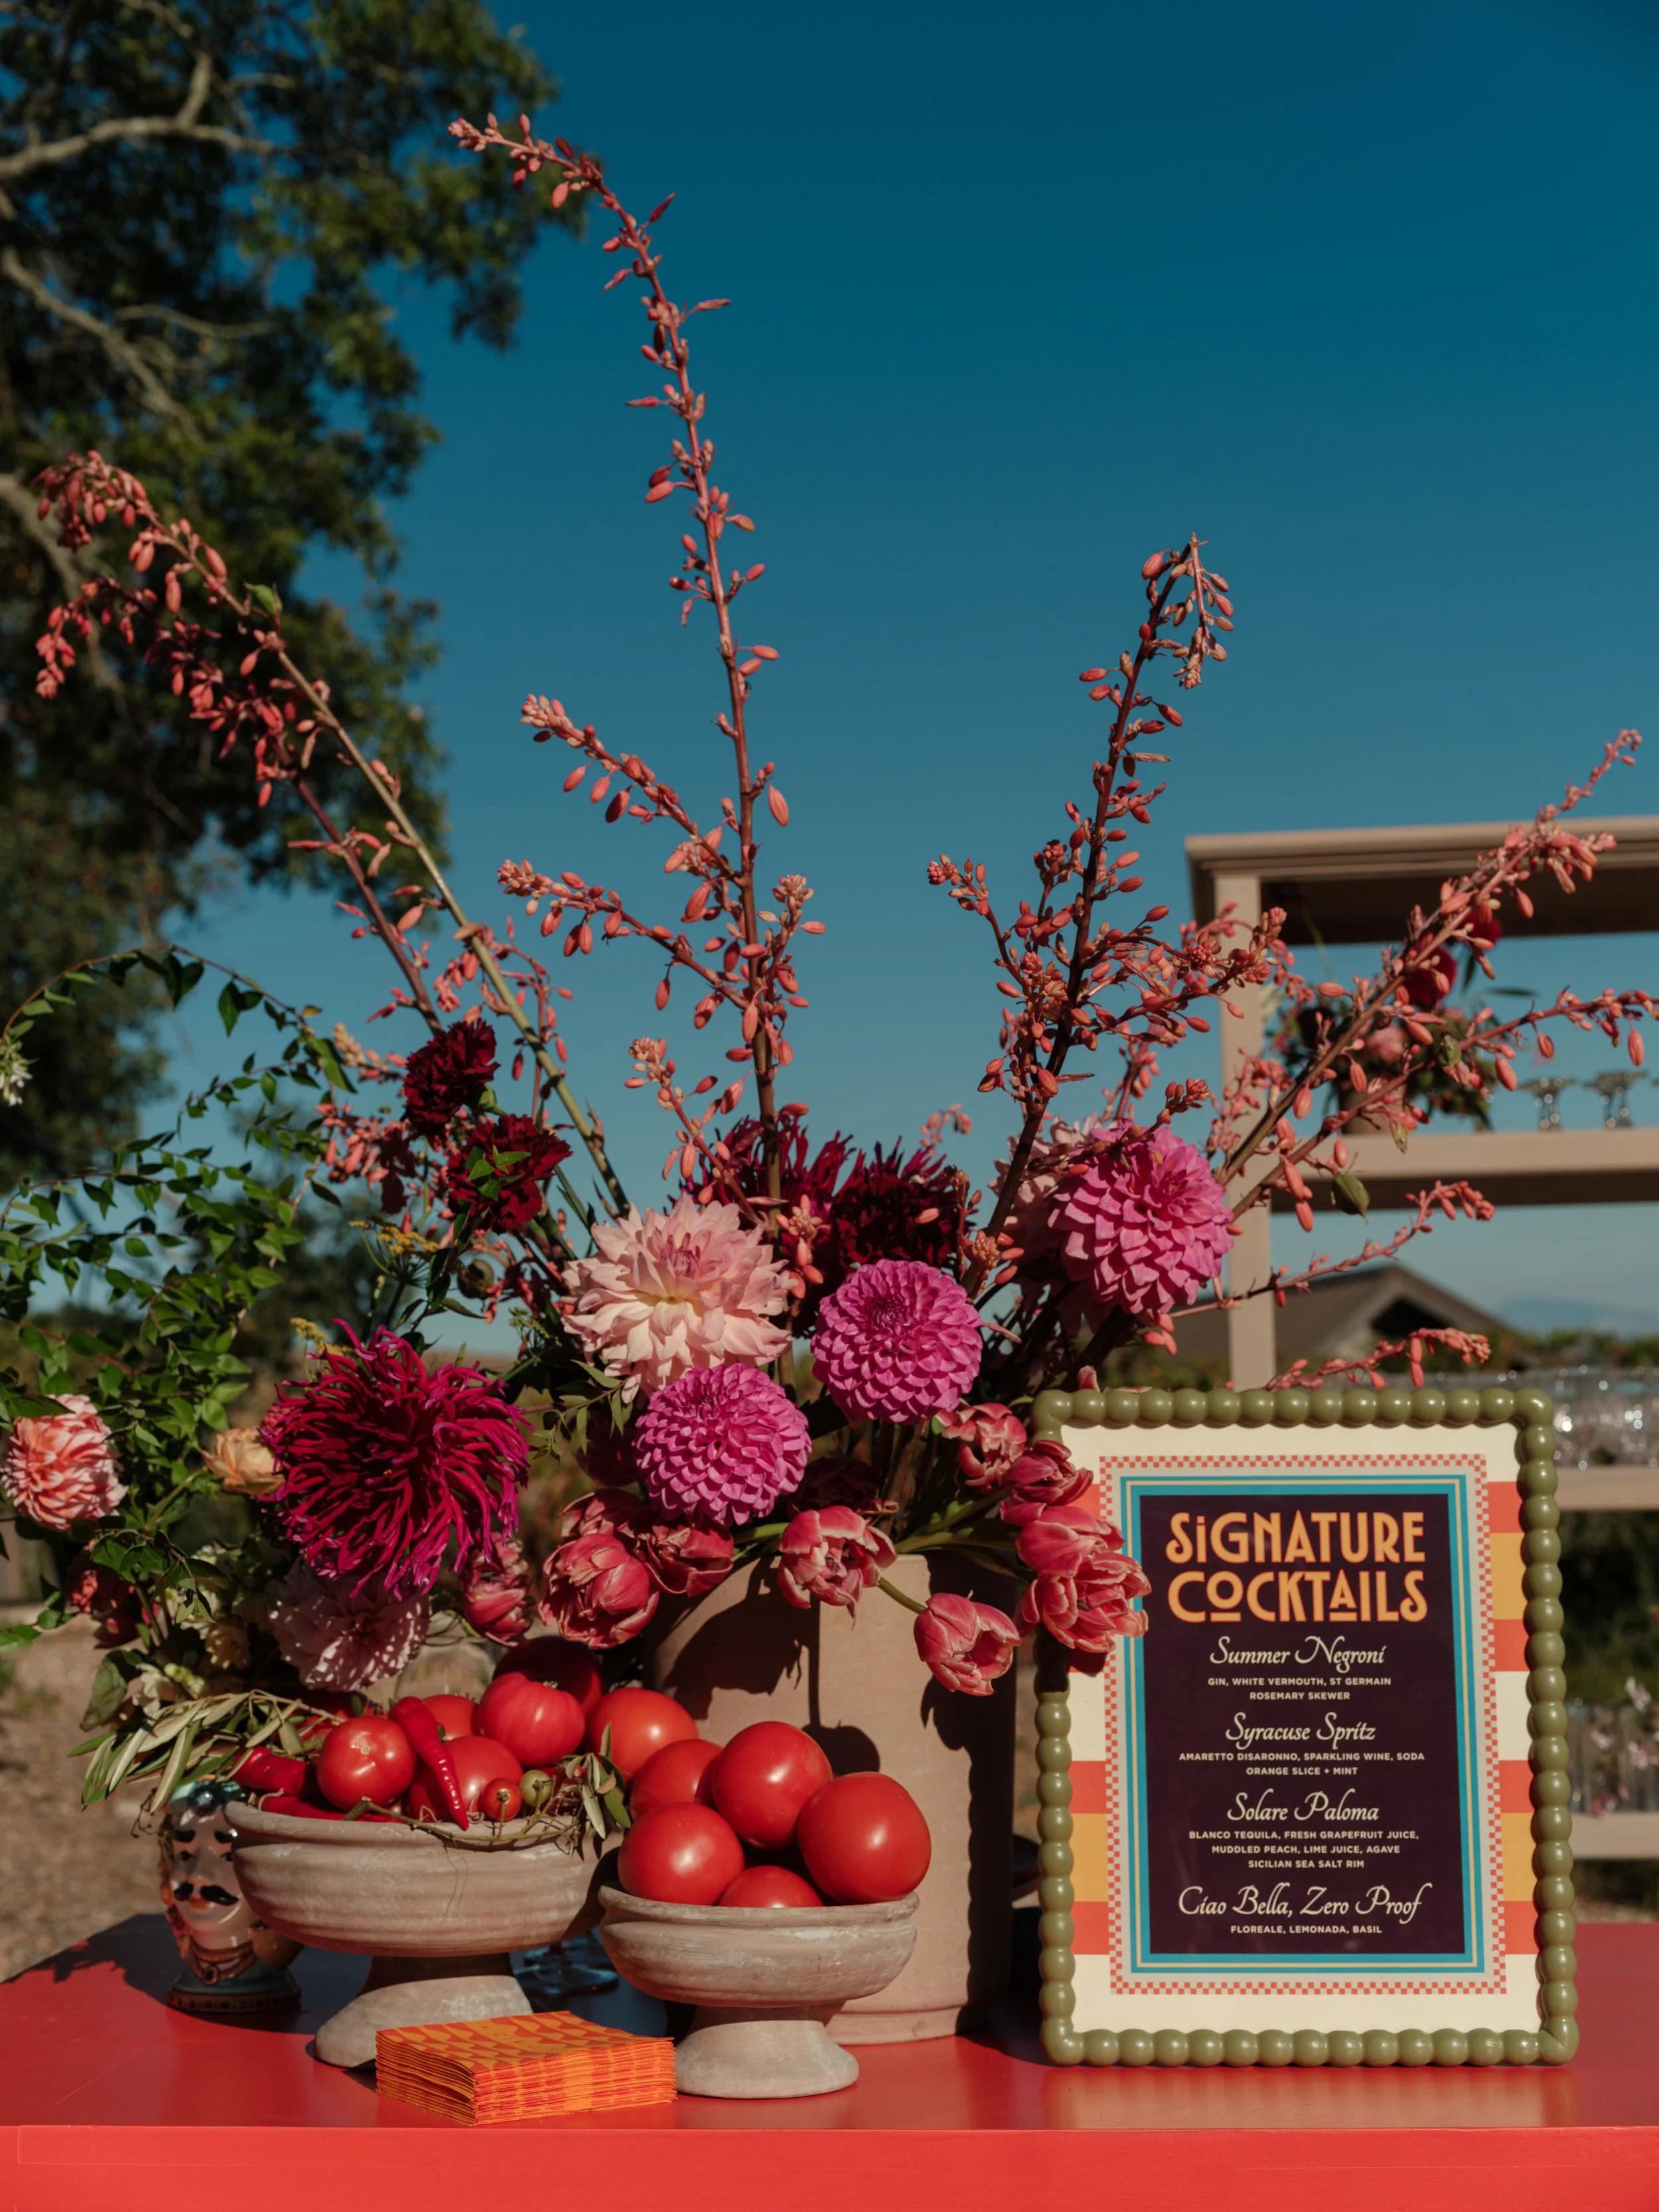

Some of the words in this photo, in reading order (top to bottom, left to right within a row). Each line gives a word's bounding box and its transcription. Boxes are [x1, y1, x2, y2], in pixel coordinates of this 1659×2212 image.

[1169, 1569, 1427, 1622] COCKTAILS
[1210, 1636, 1290, 1664] Summer
[1295, 1636, 1386, 1673] Negroni
[1207, 1677, 1229, 1686] GIN,
[1231, 1677, 1265, 1686] WHITE
[1267, 1677, 1327, 1686] VERMOUTH,
[1329, 1677, 1342, 1686] ST
[1344, 1677, 1392, 1686] GERMAIN
[1250, 1692, 1305, 1700] ROSEMARY
[1307, 1691, 1350, 1700] SKEWER
[1226, 1712, 1311, 1750] Syracuse
[1317, 1712, 1376, 1749] Spritz
[1179, 1752, 1234, 1761] AMARETTO
[1236, 1752, 1301, 1762] DISARONNO,
[1303, 1752, 1360, 1761] SPARKLING
[1363, 1752, 1394, 1761] WINE,
[1396, 1752, 1425, 1761] SODA
[1246, 1767, 1289, 1775] ORANGE
[1291, 1767, 1321, 1775] SLICE
[1333, 1767, 1358, 1775] MINT
[1227, 1789, 1288, 1820] Solare
[1294, 1788, 1379, 1820] Paloma
[1189, 1830, 1231, 1840] BLANCO
[1234, 1830, 1281, 1840] TEQUILA,
[1283, 1830, 1317, 1840] FRESH
[1319, 1830, 1384, 1840] GRAPEFRUIT
[1386, 1830, 1419, 1840] JUICE,
[1211, 1845, 1261, 1854] MUDDLED
[1263, 1845, 1301, 1854] PEACH,
[1303, 1845, 1328, 1854] LIME
[1330, 1845, 1363, 1854] JUICE,
[1366, 1845, 1400, 1854] AGAVE
[1248, 1860, 1293, 1868] SICILIAN
[1295, 1860, 1315, 1868] SEA
[1318, 1860, 1343, 1868] SALT
[1346, 1860, 1364, 1868] RIM
[1179, 1886, 1226, 1914] Ciao
[1232, 1882, 1293, 1918] Bella,
[1300, 1886, 1349, 1915] Zero
[1354, 1883, 1433, 1925] Proof
[1230, 1925, 1286, 1935] FLOREALE,
[1289, 1925, 1350, 1935] LEMONADA,
[1352, 1925, 1382, 1934] BASIL
